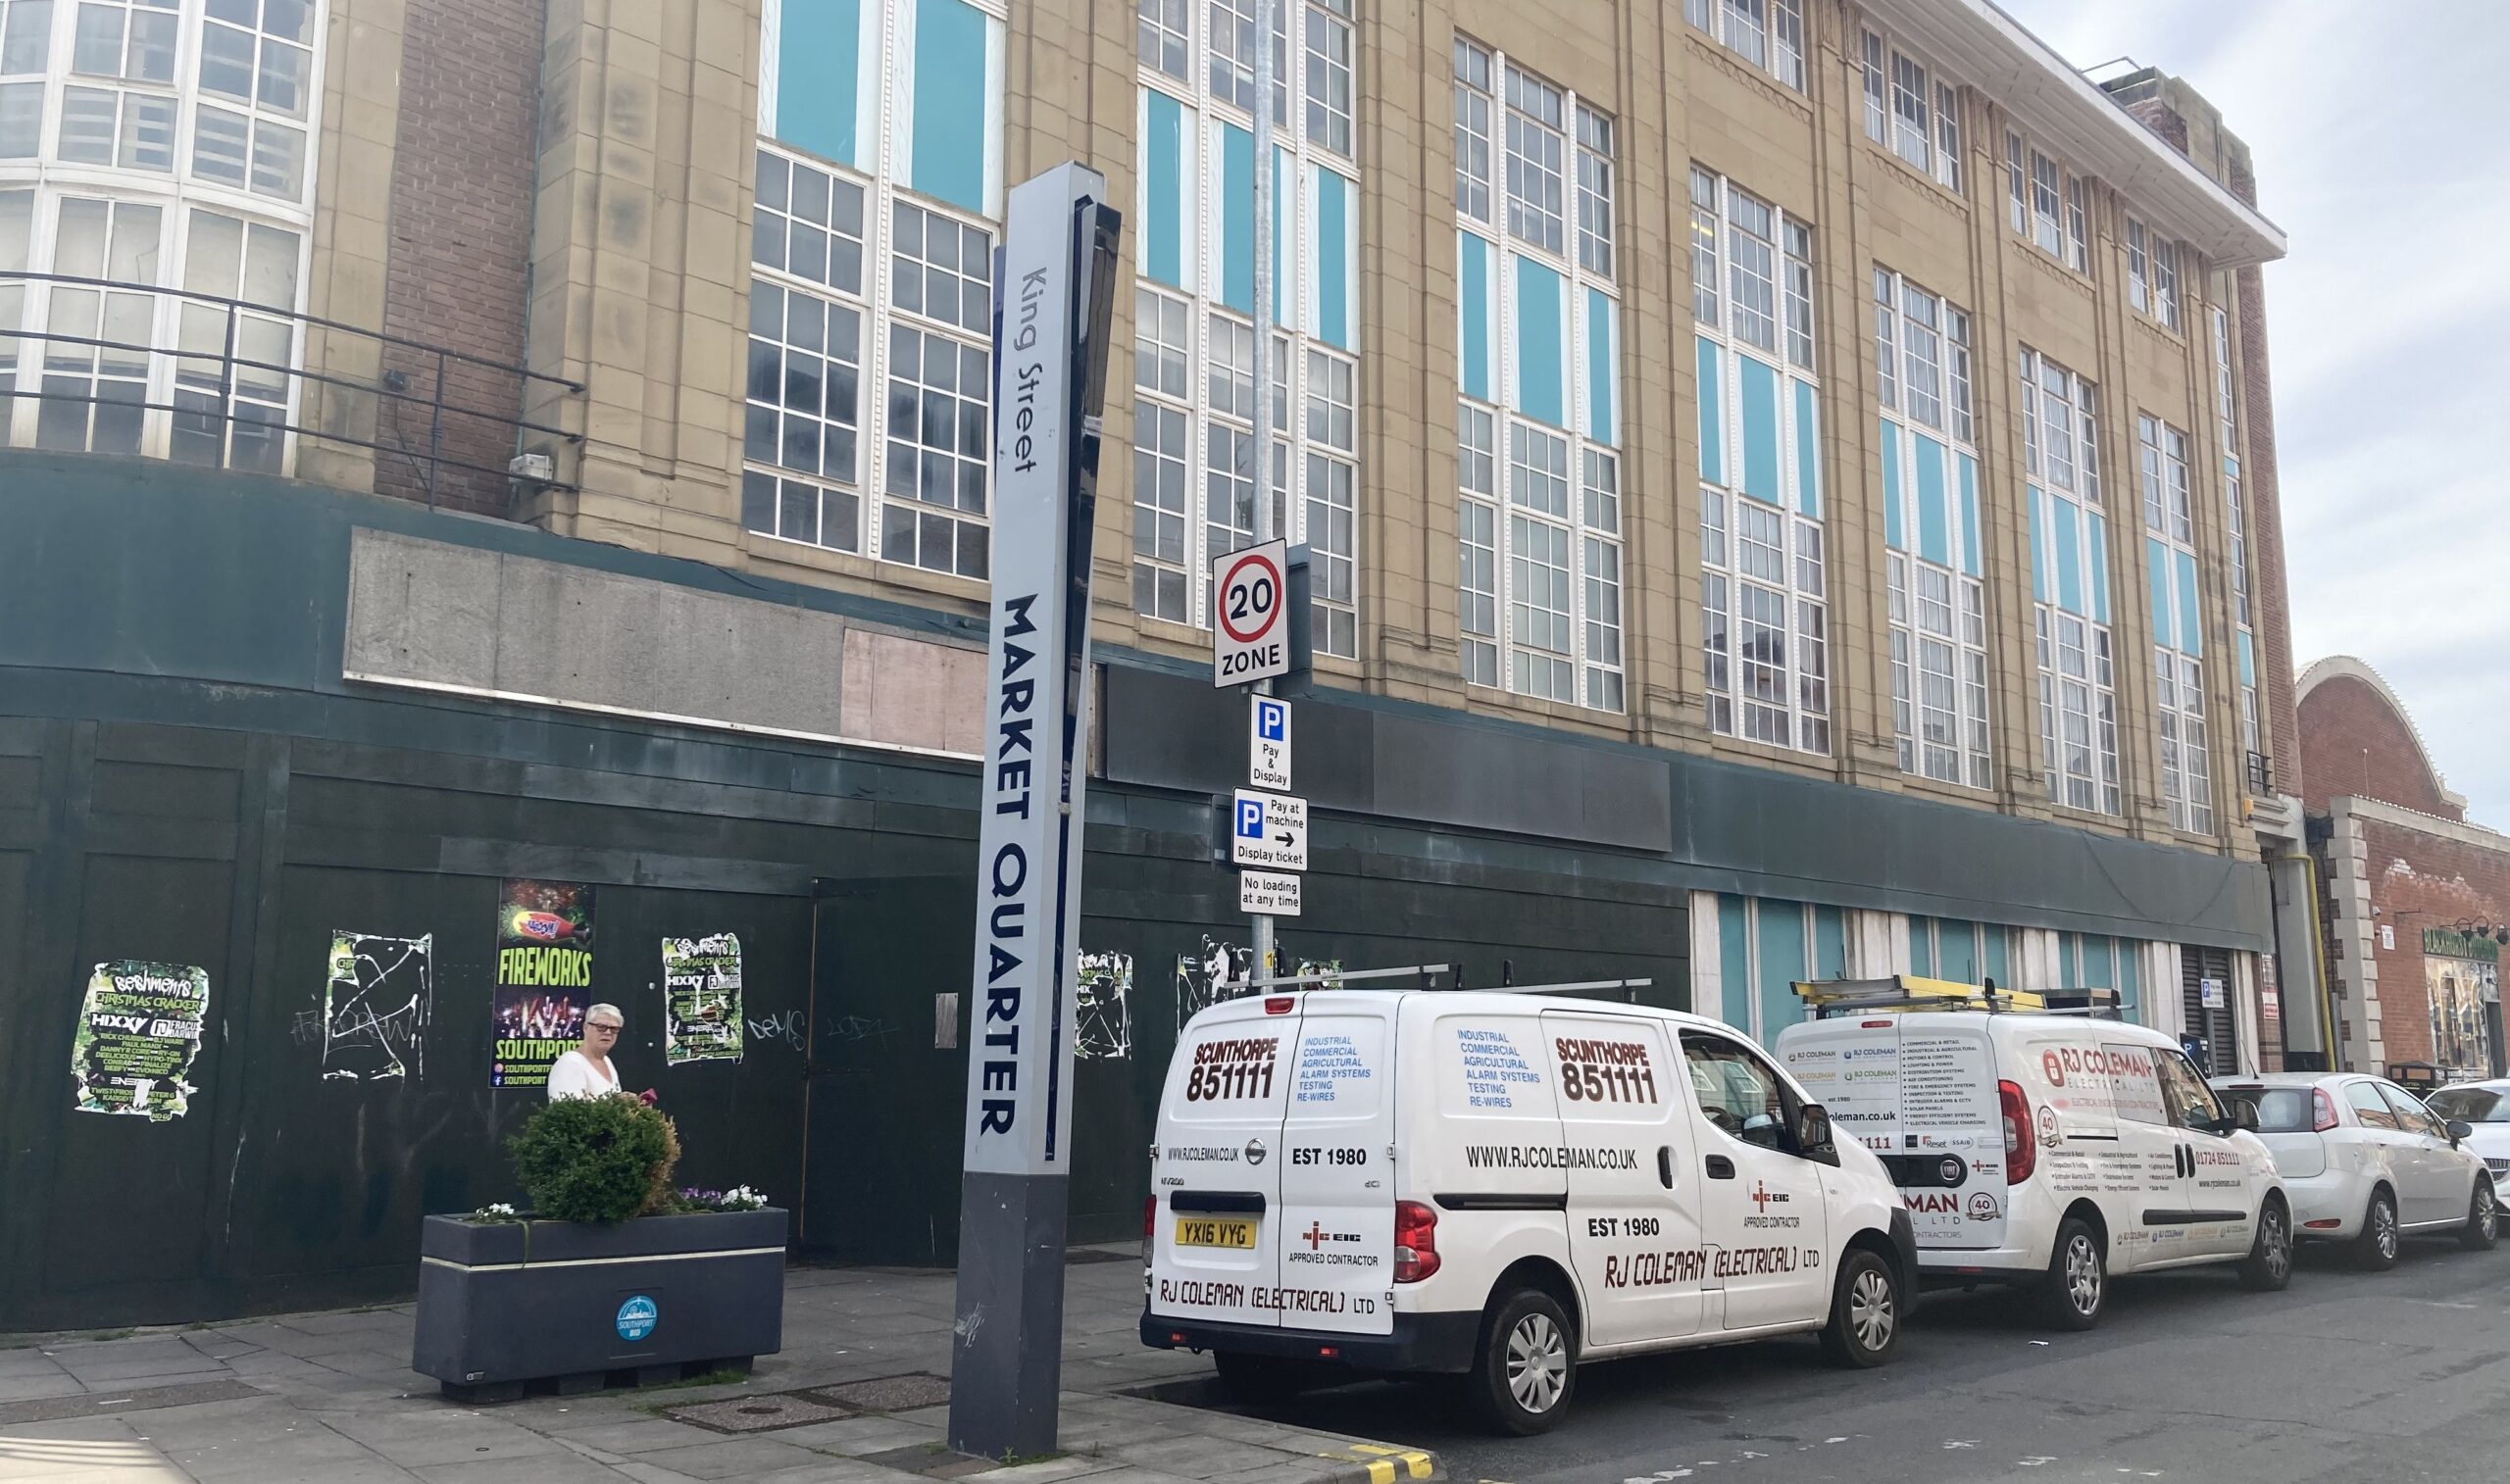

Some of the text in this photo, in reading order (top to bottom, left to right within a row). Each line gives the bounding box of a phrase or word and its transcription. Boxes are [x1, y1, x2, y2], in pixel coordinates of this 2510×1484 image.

[1014, 267, 1047, 473] King Street
[1230, 578, 1273, 620] 20
[1223, 644, 1280, 676] ZONE
[1263, 744, 1279, 759] Pay
[1268, 759, 1275, 768] &
[1253, 768, 1287, 786] Display
[1271, 800, 1299, 814] Pay at
[1266, 815, 1304, 828] machine
[1238, 846, 1303, 865] Display ticket
[980, 593, 1039, 1138] MARKET QUARTER
[1244, 877, 1297, 895] No loading
[1242, 893, 1299, 907] at any time
[498, 947, 592, 987] FIREWORKS
[96, 992, 201, 1013] CHRISTMAS CRACKER
[92, 1014, 149, 1034] HIXXY
[1305, 1036, 1352, 1046] INDUSTRIAL
[1458, 1029, 1510, 1043] INDUSTRIAL
[1194, 1037, 1280, 1065] SCUNTHORPE
[1303, 1047, 1358, 1057] COMMERCIAL
[1460, 1043, 1520, 1057] COMMERCIAL
[1556, 1037, 1650, 1066] SCUNTHORPE
[1302, 1059, 1363, 1067] AGRICULTURAL
[1464, 1056, 1529, 1069] AGRICULTURAL
[2060, 1048, 2152, 1078] RJ COLEMAN
[504, 1076, 547, 1085] SOUTHPORT
[1300, 1069, 1372, 1079] ALARM SYSTEMS
[1467, 1069, 1540, 1083] ALARM SYSTEMS
[1186, 1062, 1275, 1102] 851111
[1299, 1081, 1333, 1090] TESTING
[1468, 1082, 1506, 1094] TESTING
[1562, 1063, 1658, 1105] 851111
[1297, 1092, 1335, 1102] RE-WIRES
[1470, 1096, 1512, 1108] RE-WIRES
[2042, 1116, 2053, 1130] 40
[1927, 1140, 1947, 1149] Reset
[1168, 1148, 1239, 1162] WWW.RJCOLEMAN.CO.UK
[1292, 1148, 1367, 1165] EST 1980
[1466, 1145, 1638, 1169] WWW.RJCOLEMAN.CO.UK
[2195, 1151, 2240, 1165] 01724 851111
[1975, 1200, 1990, 1210] 40
[1587, 1217, 1660, 1237] EST 1980
[1744, 1216, 1800, 1228] APPROVED CONTRACTOR
[1184, 1222, 1246, 1245] YX16 VYG
[1288, 1253, 1379, 1266] APPROVED CONTRACTOR
[1605, 1246, 1820, 1289] RJ COLEMAN (ELECTRICAL) LTD
[1160, 1279, 1375, 1314] RJ COLEMAN (ELECTRICAL) LTD
[619, 1318, 654, 1330] SOUTHPORT
[629, 1329, 641, 1338] BID
